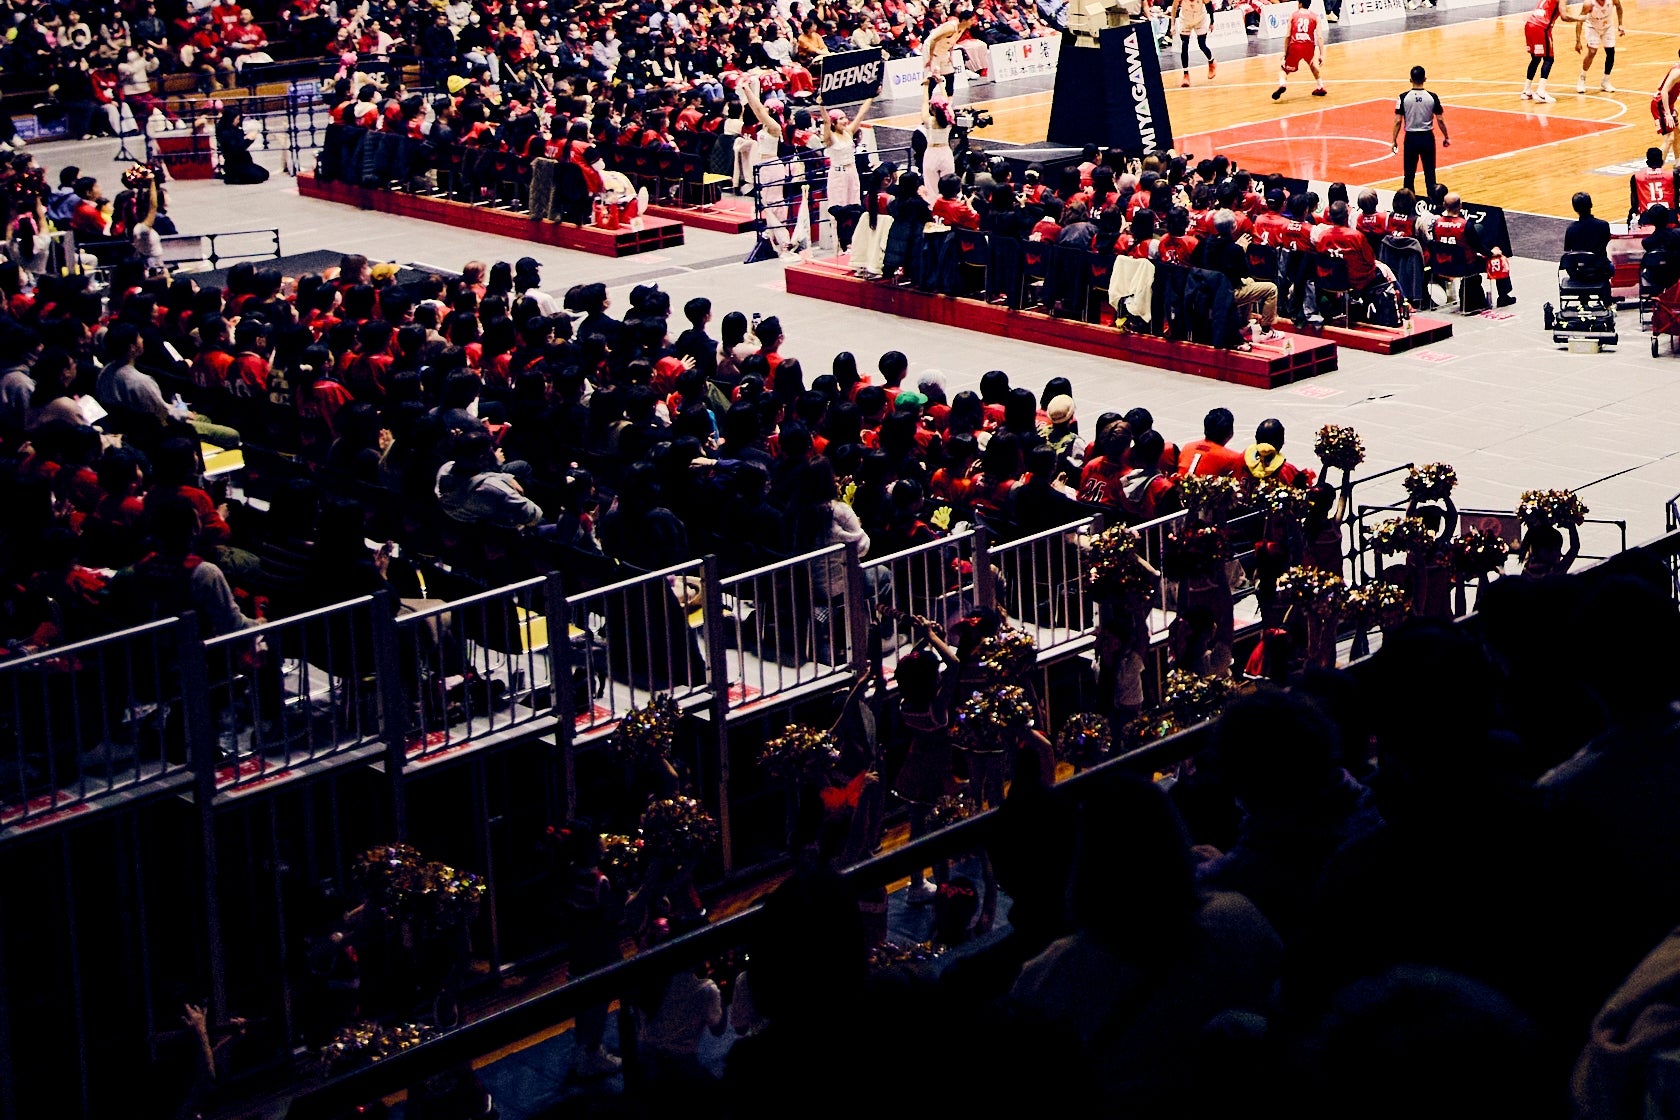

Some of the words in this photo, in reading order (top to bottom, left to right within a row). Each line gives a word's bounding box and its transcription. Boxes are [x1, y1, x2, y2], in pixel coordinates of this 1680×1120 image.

[823, 60, 880, 93] DEFENSE
[902, 72, 922, 84] BOAT
[1124, 32, 1157, 155] MIYAGAWA
[1649, 181, 1663, 201] 15
